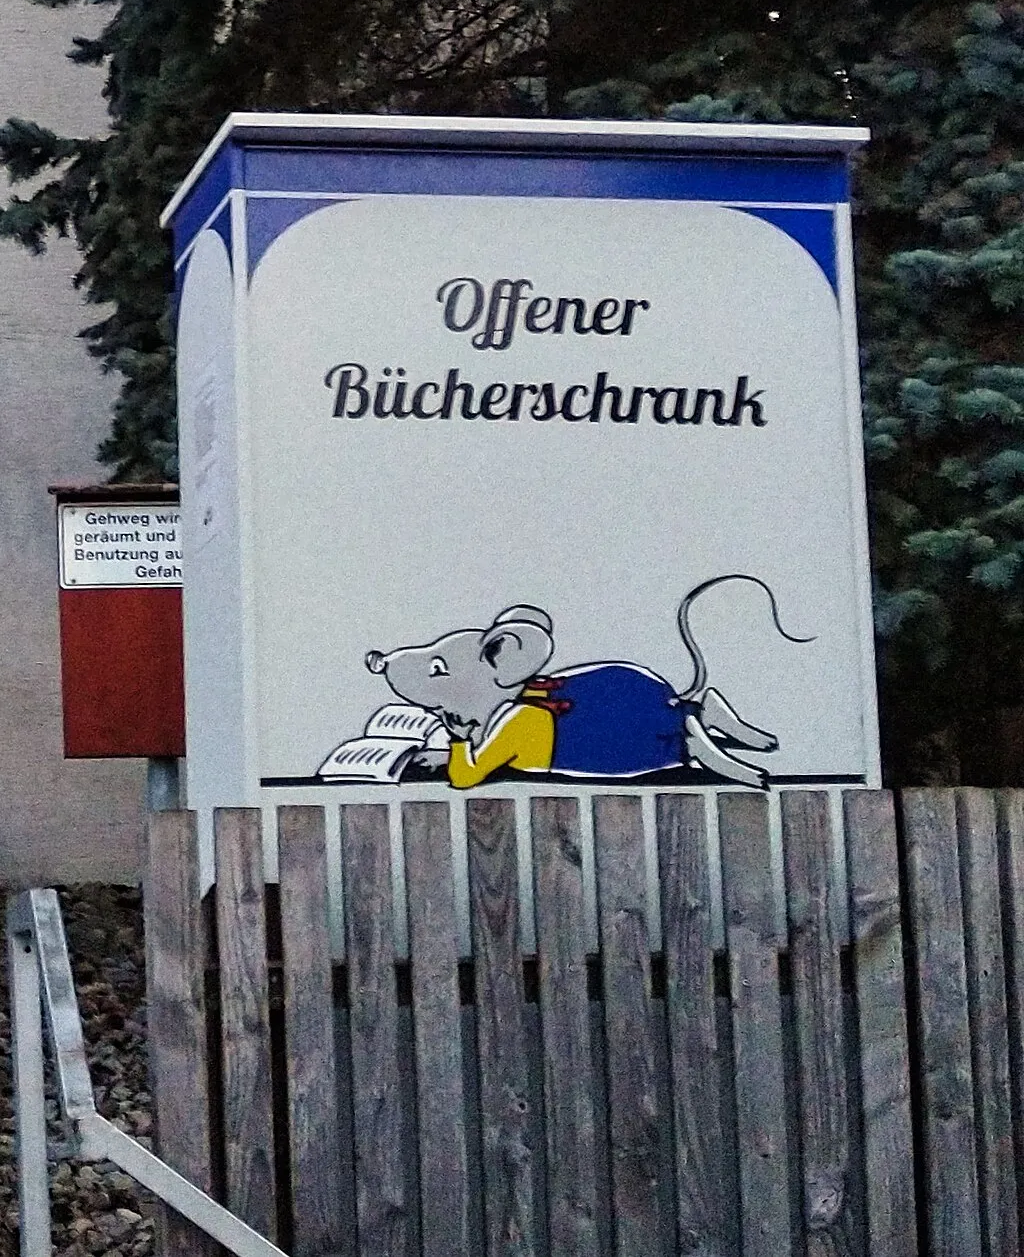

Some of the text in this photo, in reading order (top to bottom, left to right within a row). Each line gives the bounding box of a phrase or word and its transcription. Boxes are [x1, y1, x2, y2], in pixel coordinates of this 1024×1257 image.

[436, 277, 651, 351] Offener
[324, 363, 768, 427] Bücherschrank
[85, 512, 150, 527] Gehweg
[74, 530, 176, 546] geräumt und
[74, 549, 159, 563] Benutzung
